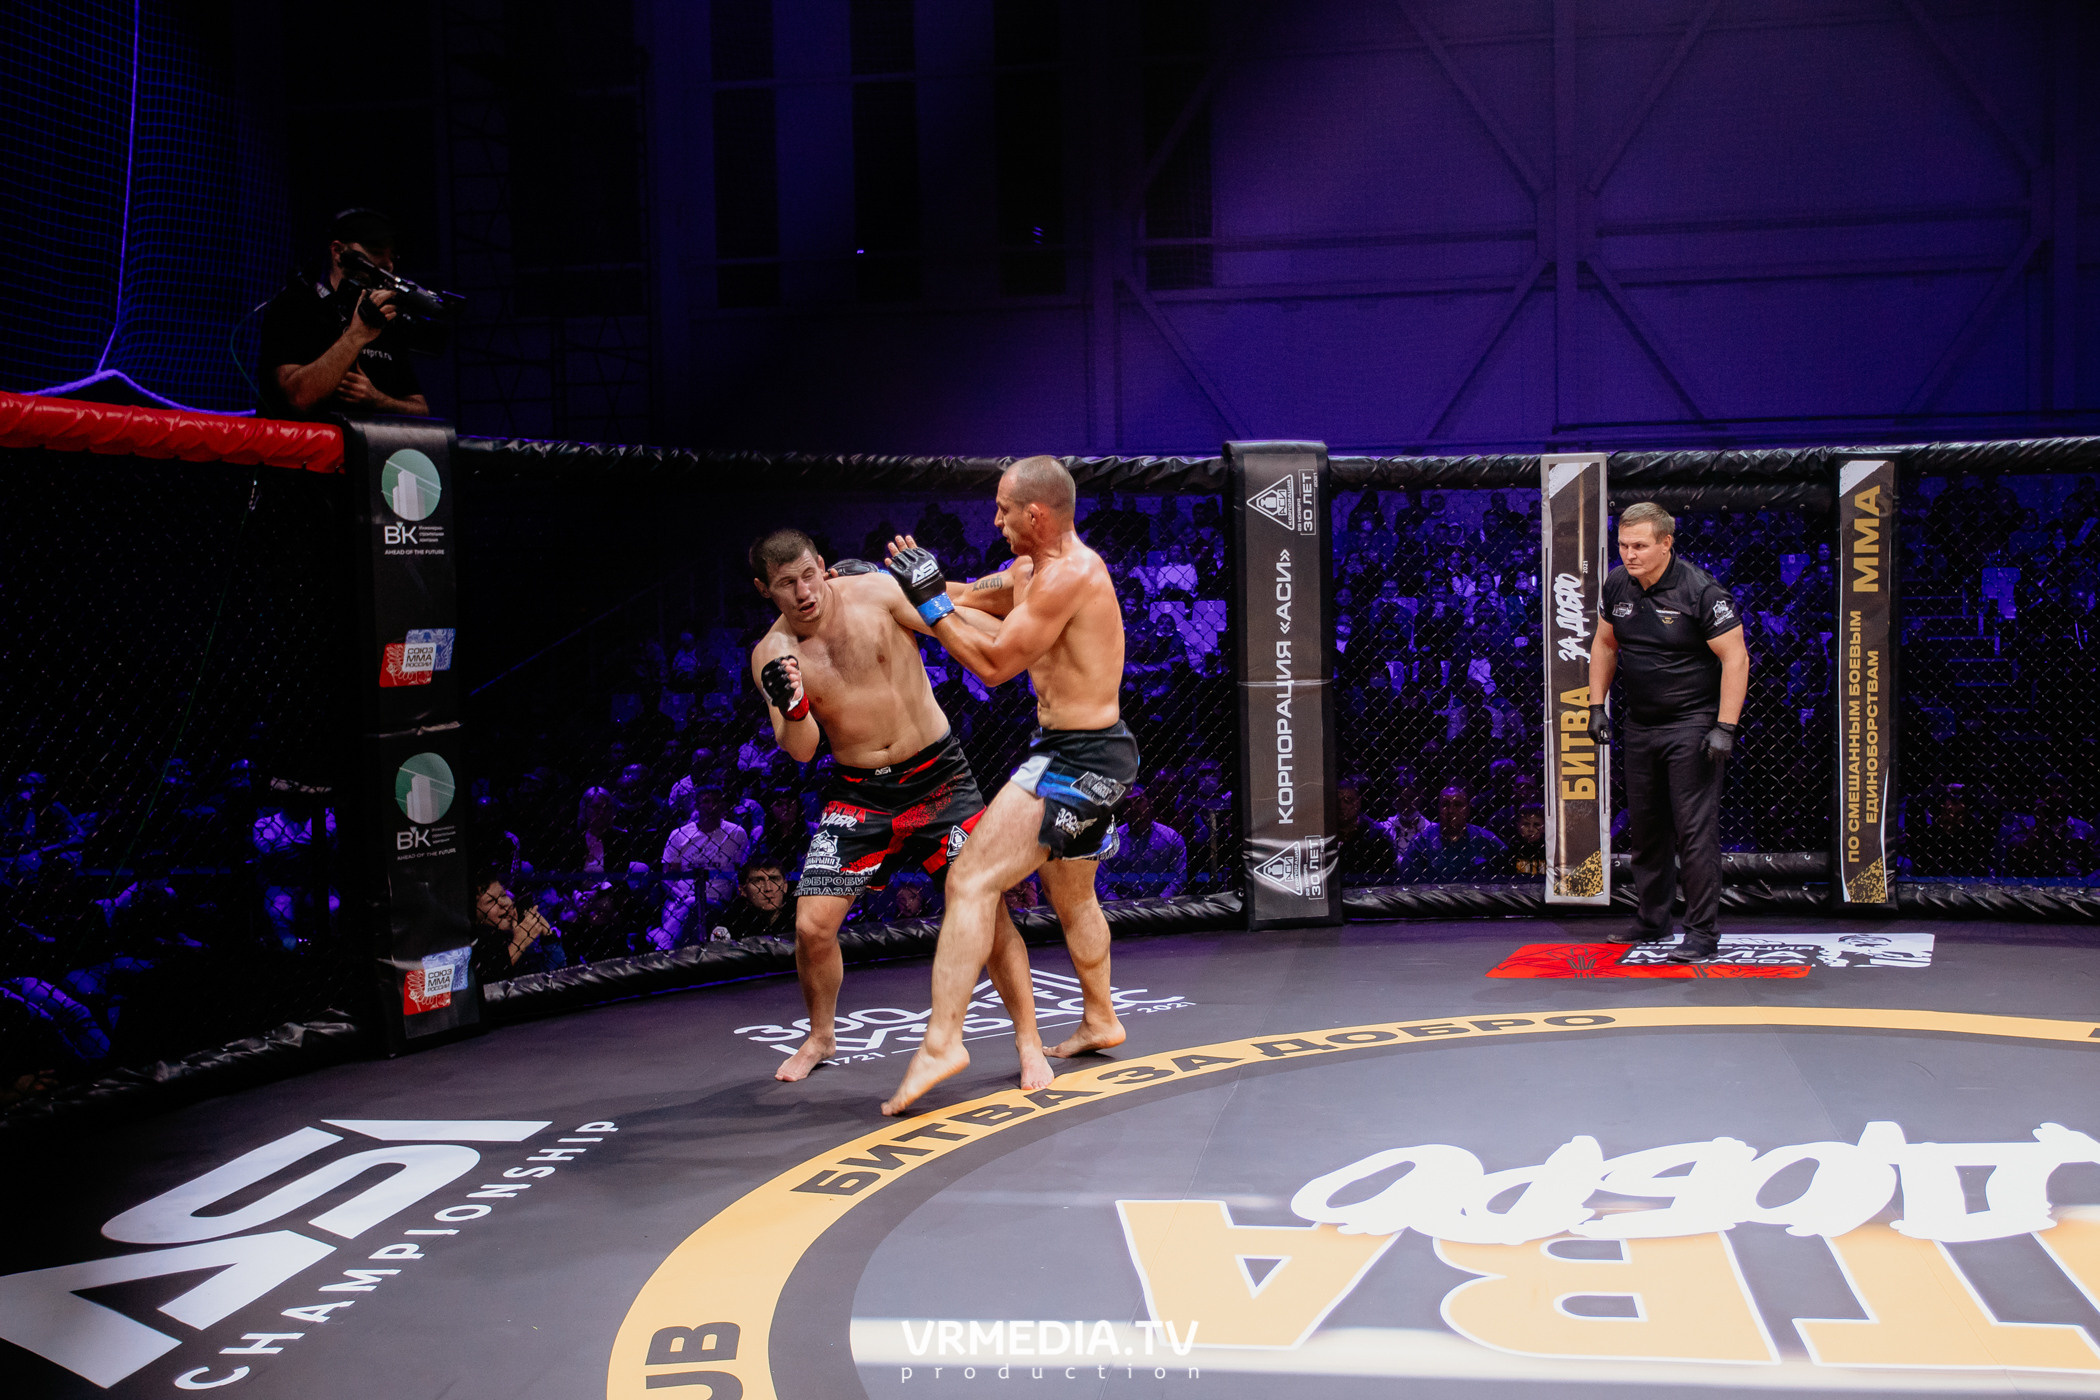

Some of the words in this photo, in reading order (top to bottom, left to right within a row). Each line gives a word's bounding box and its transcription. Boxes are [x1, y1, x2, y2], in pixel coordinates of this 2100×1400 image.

[1302, 472, 1312, 505] ЛЕТ
[1303, 509, 1313, 532] 30
[912, 560, 939, 584] ASI
[1275, 549, 1293, 635] «АСИ»
[1553, 572, 1591, 637] ДОБРО
[1848, 610, 1862, 696] БОЕВЫМ
[1275, 641, 1295, 825] КОРПОРАЦИЯ
[1560, 686, 1596, 800] БИТВА
[1848, 700, 1861, 832] СМЕШАННЫМ
[1866, 650, 1879, 824] ЕДИНОБОРСТВАМ
[1309, 839, 1319, 870] ЛЕТ
[1310, 875, 1321, 896] 30
[1848, 836, 1860, 863] ПО
[1137, 1001, 1197, 1014] 2021
[789, 1087, 1104, 1196] БИТВА
[1096, 1053, 1243, 1085] ЗА
[1250, 1013, 1618, 1060] ДОБРО
[173, 1120, 620, 1391] CHAMPIONSHIP
